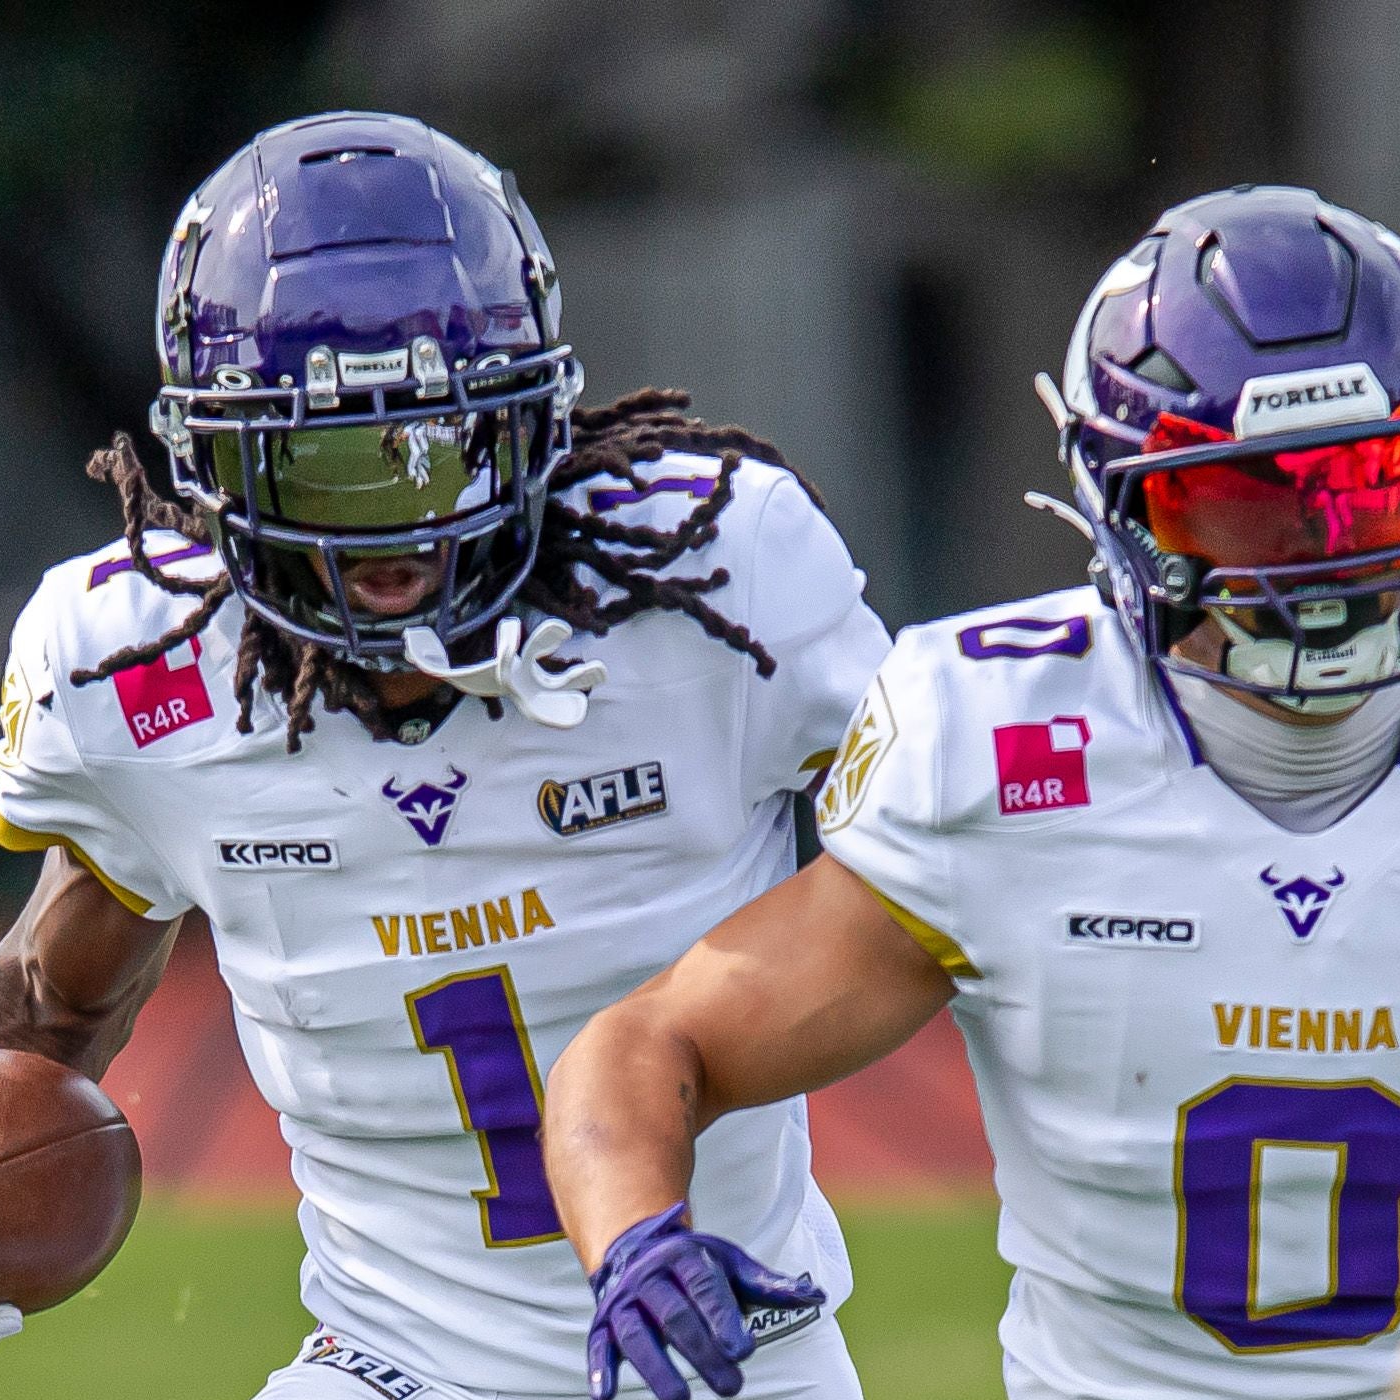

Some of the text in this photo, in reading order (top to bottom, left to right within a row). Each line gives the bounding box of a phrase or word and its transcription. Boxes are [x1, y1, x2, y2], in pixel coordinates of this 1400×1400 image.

[1252, 375, 1368, 413] FORELLE
[132, 698, 191, 740] R4R
[561, 764, 663, 827] AFLE
[1003, 777, 1066, 809] R4R
[371, 887, 556, 958] VIENNA
[1211, 1001, 1400, 1053] VIENNA
[404, 963, 569, 1248] 1
[314, 1347, 423, 1400] AFLE
